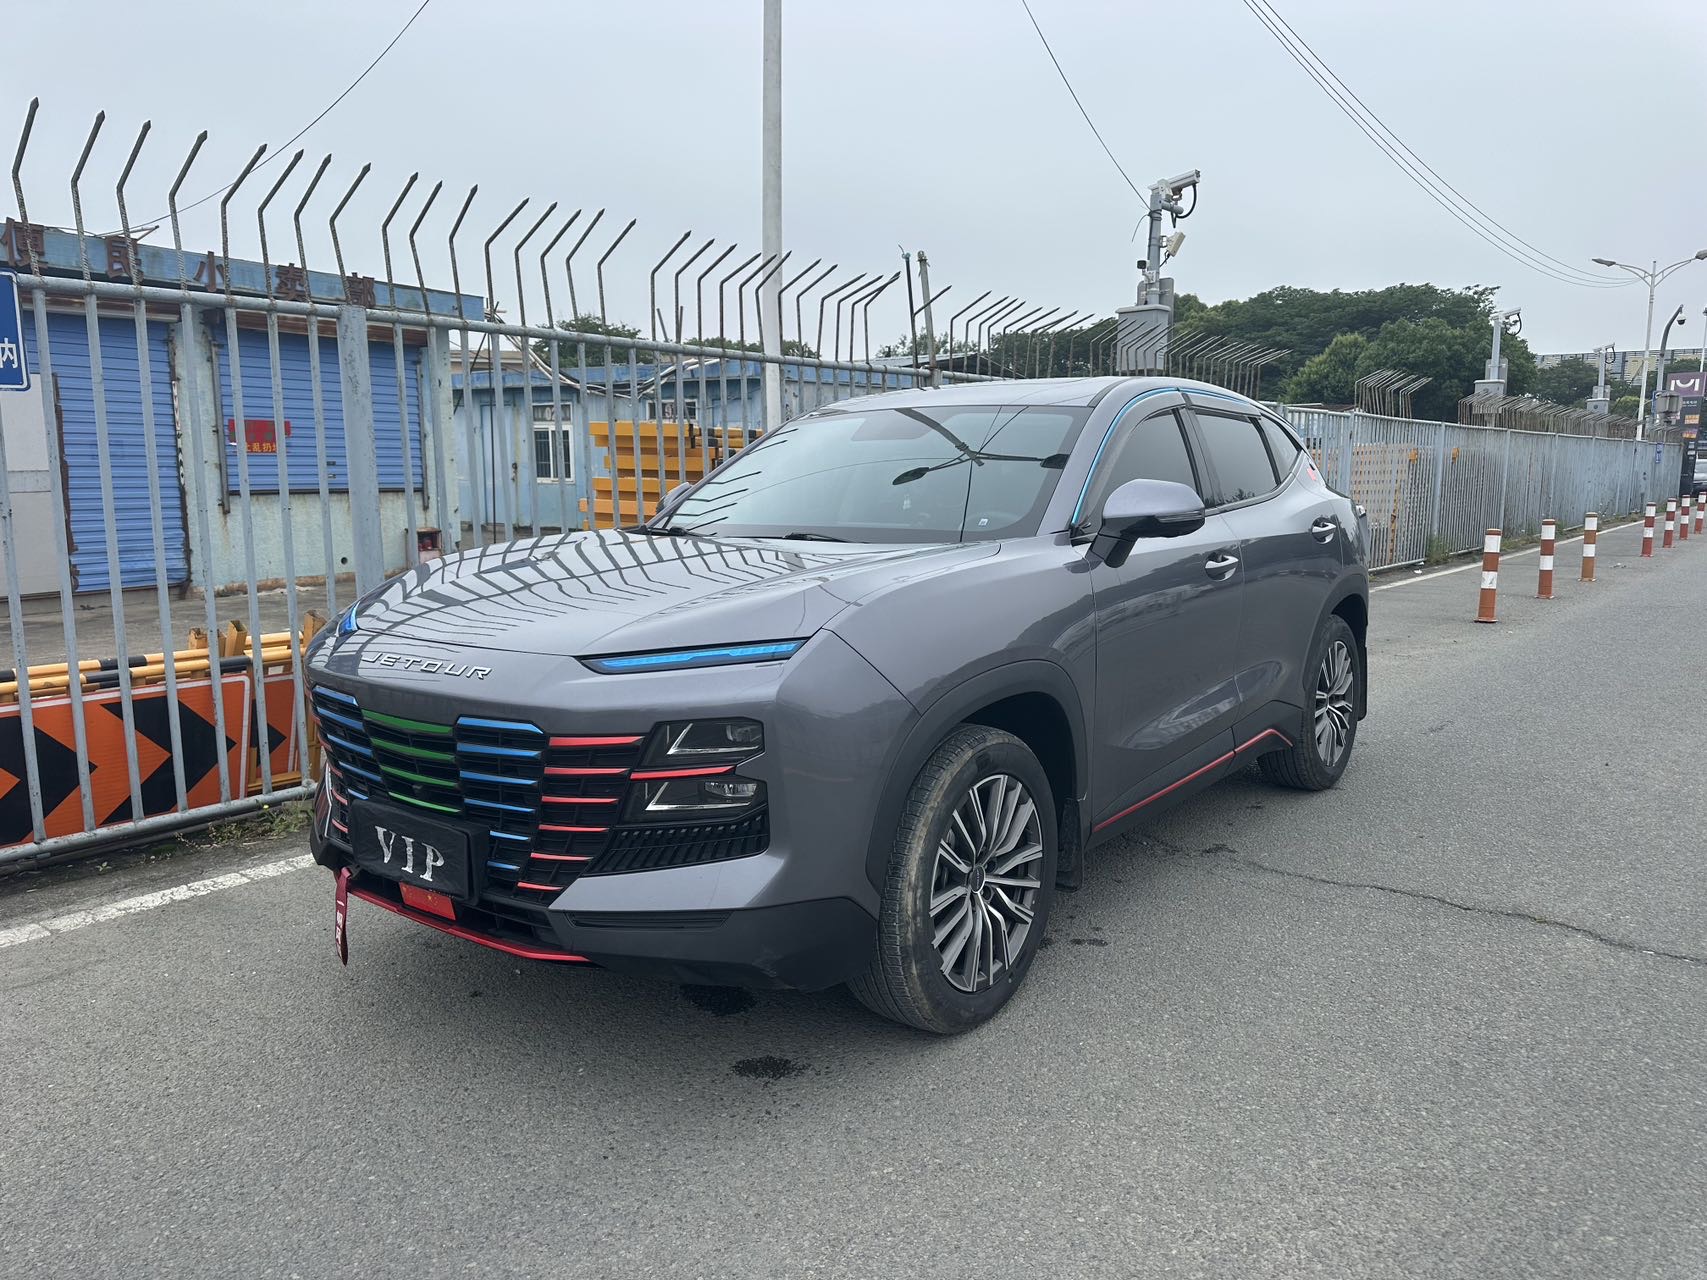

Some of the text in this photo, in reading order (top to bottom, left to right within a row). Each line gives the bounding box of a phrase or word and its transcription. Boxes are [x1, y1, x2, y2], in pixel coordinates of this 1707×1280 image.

[0, 337, 18, 368] 内
[361, 652, 493, 680] JETOUR
[374, 825, 444, 881] VIP
